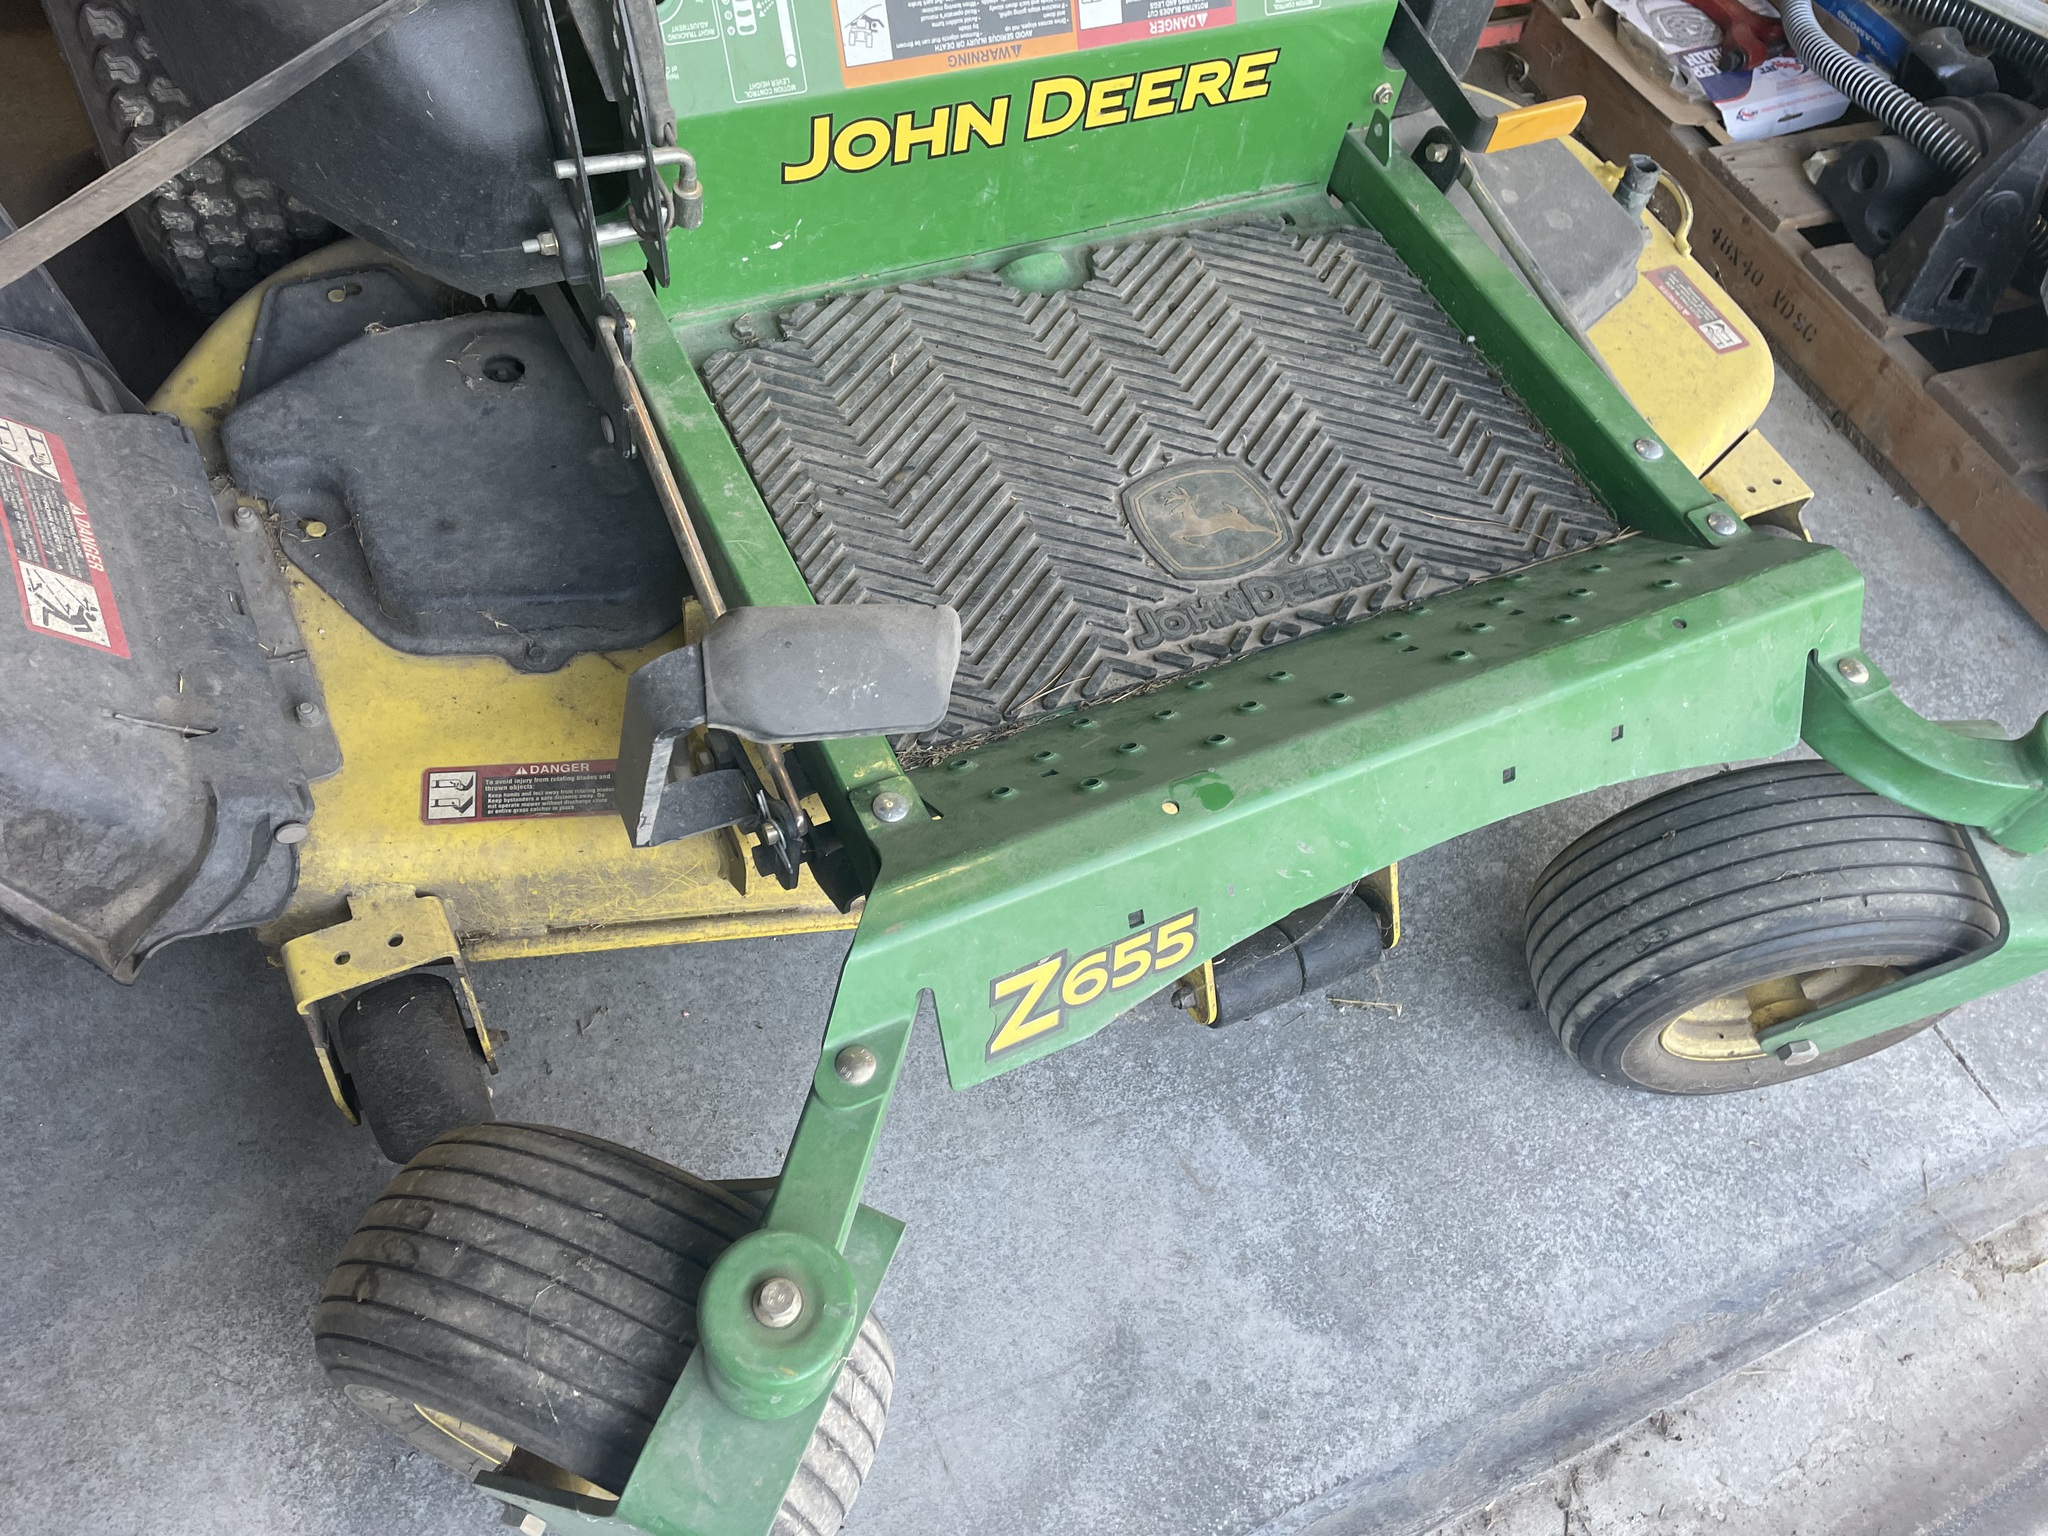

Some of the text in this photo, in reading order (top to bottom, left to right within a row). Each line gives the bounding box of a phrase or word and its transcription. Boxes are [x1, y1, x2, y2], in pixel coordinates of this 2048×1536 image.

[1145, 1, 1208, 18] ROTATING BLADES CUT
[1149, 0, 1164, 9] LEGS
[670, 20, 709, 32] ADJUSTMENT
[1148, 14, 1196, 34] DANGER
[667, 27, 714, 41] RIGHT TRACKING
[933, 29, 1033, 51] AVOID SERIOUS INJURY OR DEATH
[946, 45, 1010, 67] WARNING
[1683, 47, 1723, 67] HAIN
[665, 71, 679, 81] Heig
[748, 77, 790, 90] LEVER HEIGHT
[744, 83, 796, 98] MOTION CONTROL
[781, 48, 1282, 184] JOHN DEERE
[77, 520, 105, 573] DANGER
[1133, 549, 1391, 649] JOHN DEERE
[530, 762, 589, 774] DANGER
[986, 908, 1197, 1060] Z655
